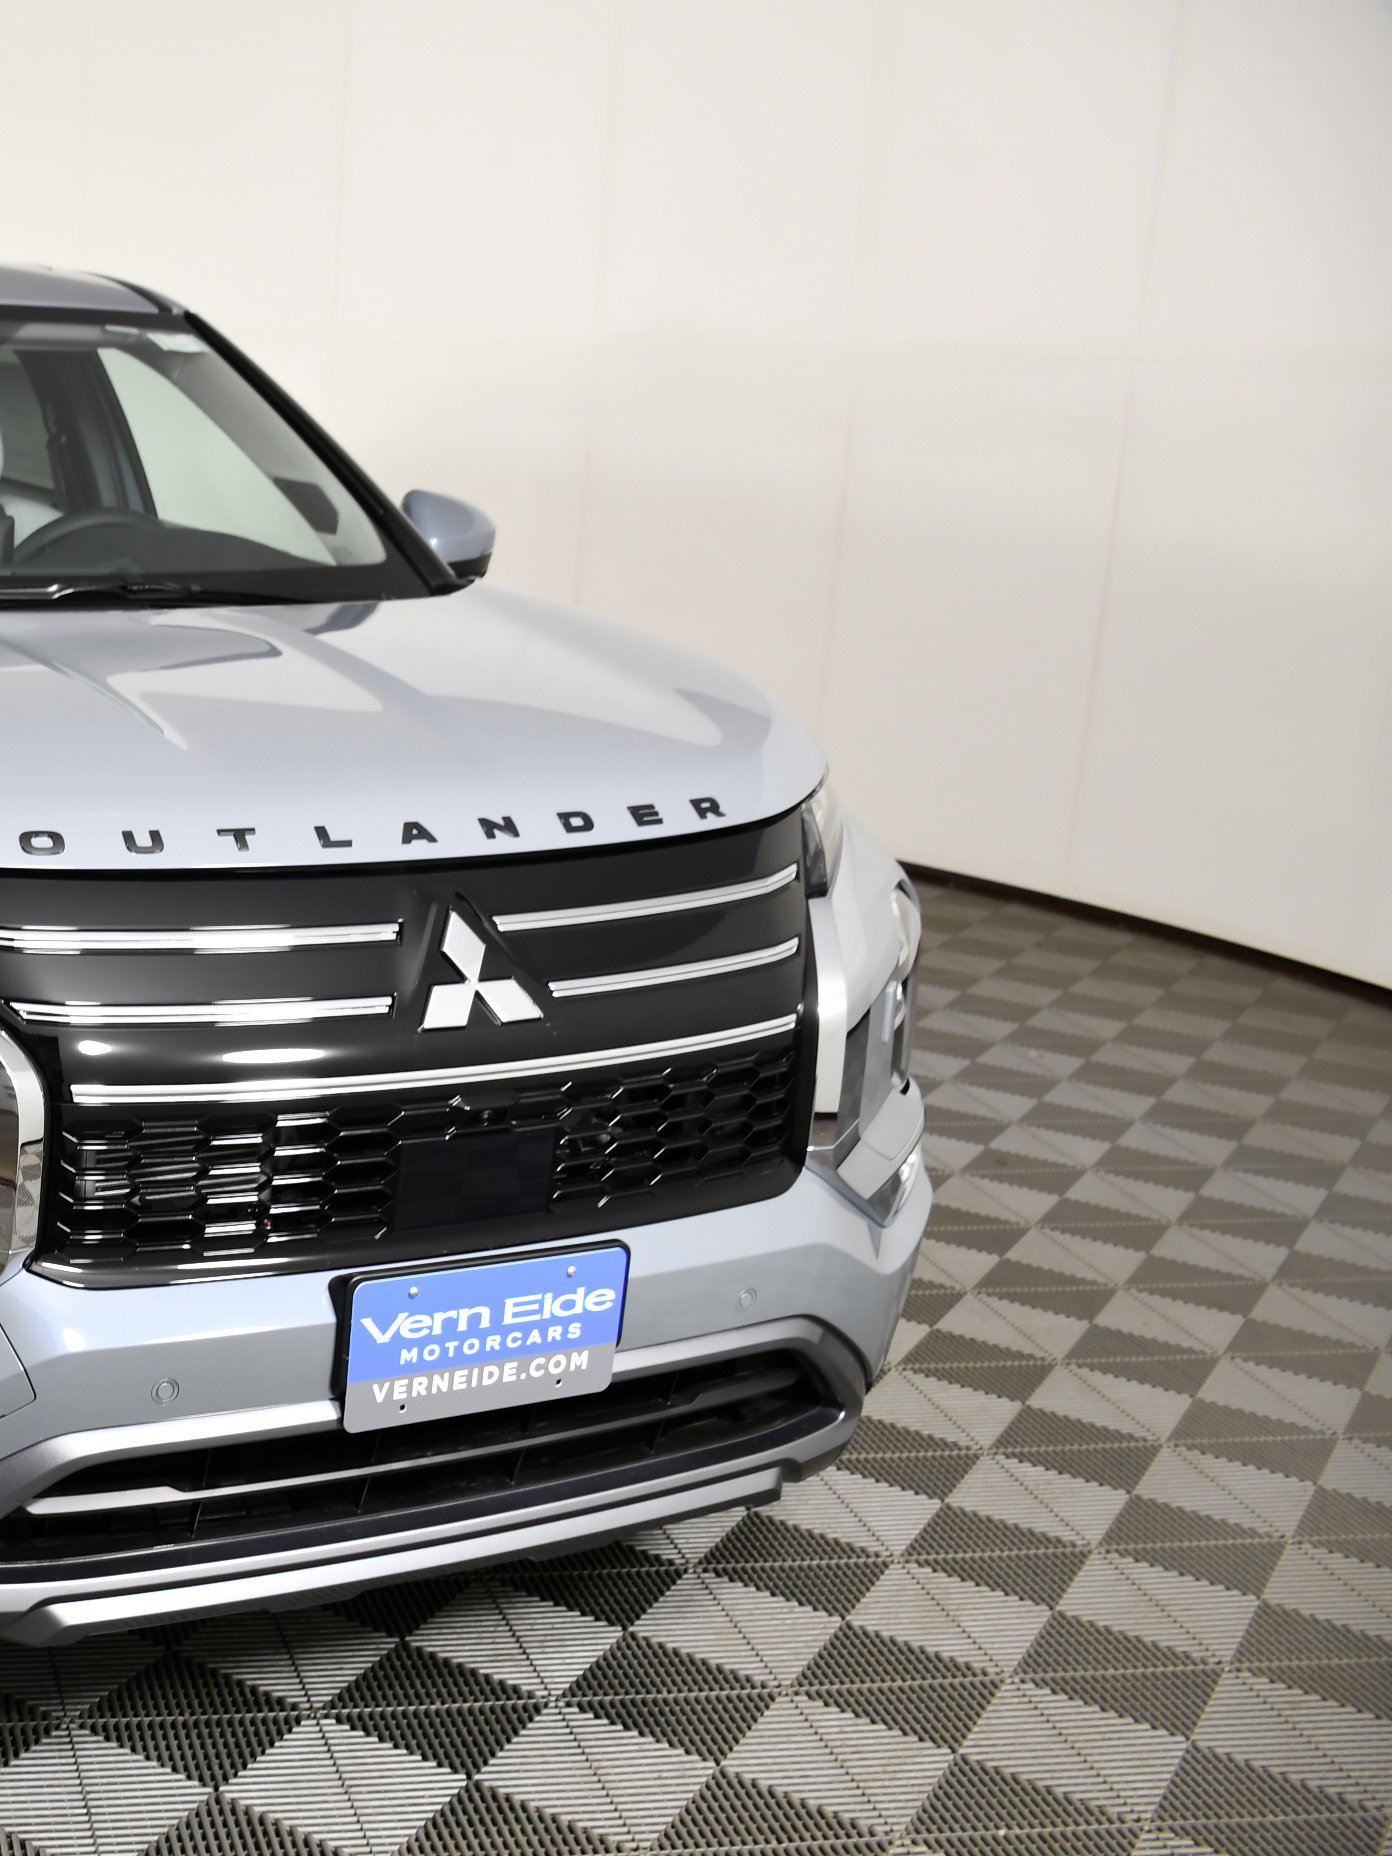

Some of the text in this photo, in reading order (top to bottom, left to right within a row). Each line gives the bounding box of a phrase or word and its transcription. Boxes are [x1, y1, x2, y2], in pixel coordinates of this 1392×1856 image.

[18, 796, 727, 855] OUTLANDER
[360, 1286, 616, 1344] Vern Eide
[399, 1322, 583, 1365] MOTORCARS
[372, 1350, 589, 1403] VERNEIDE.COM
